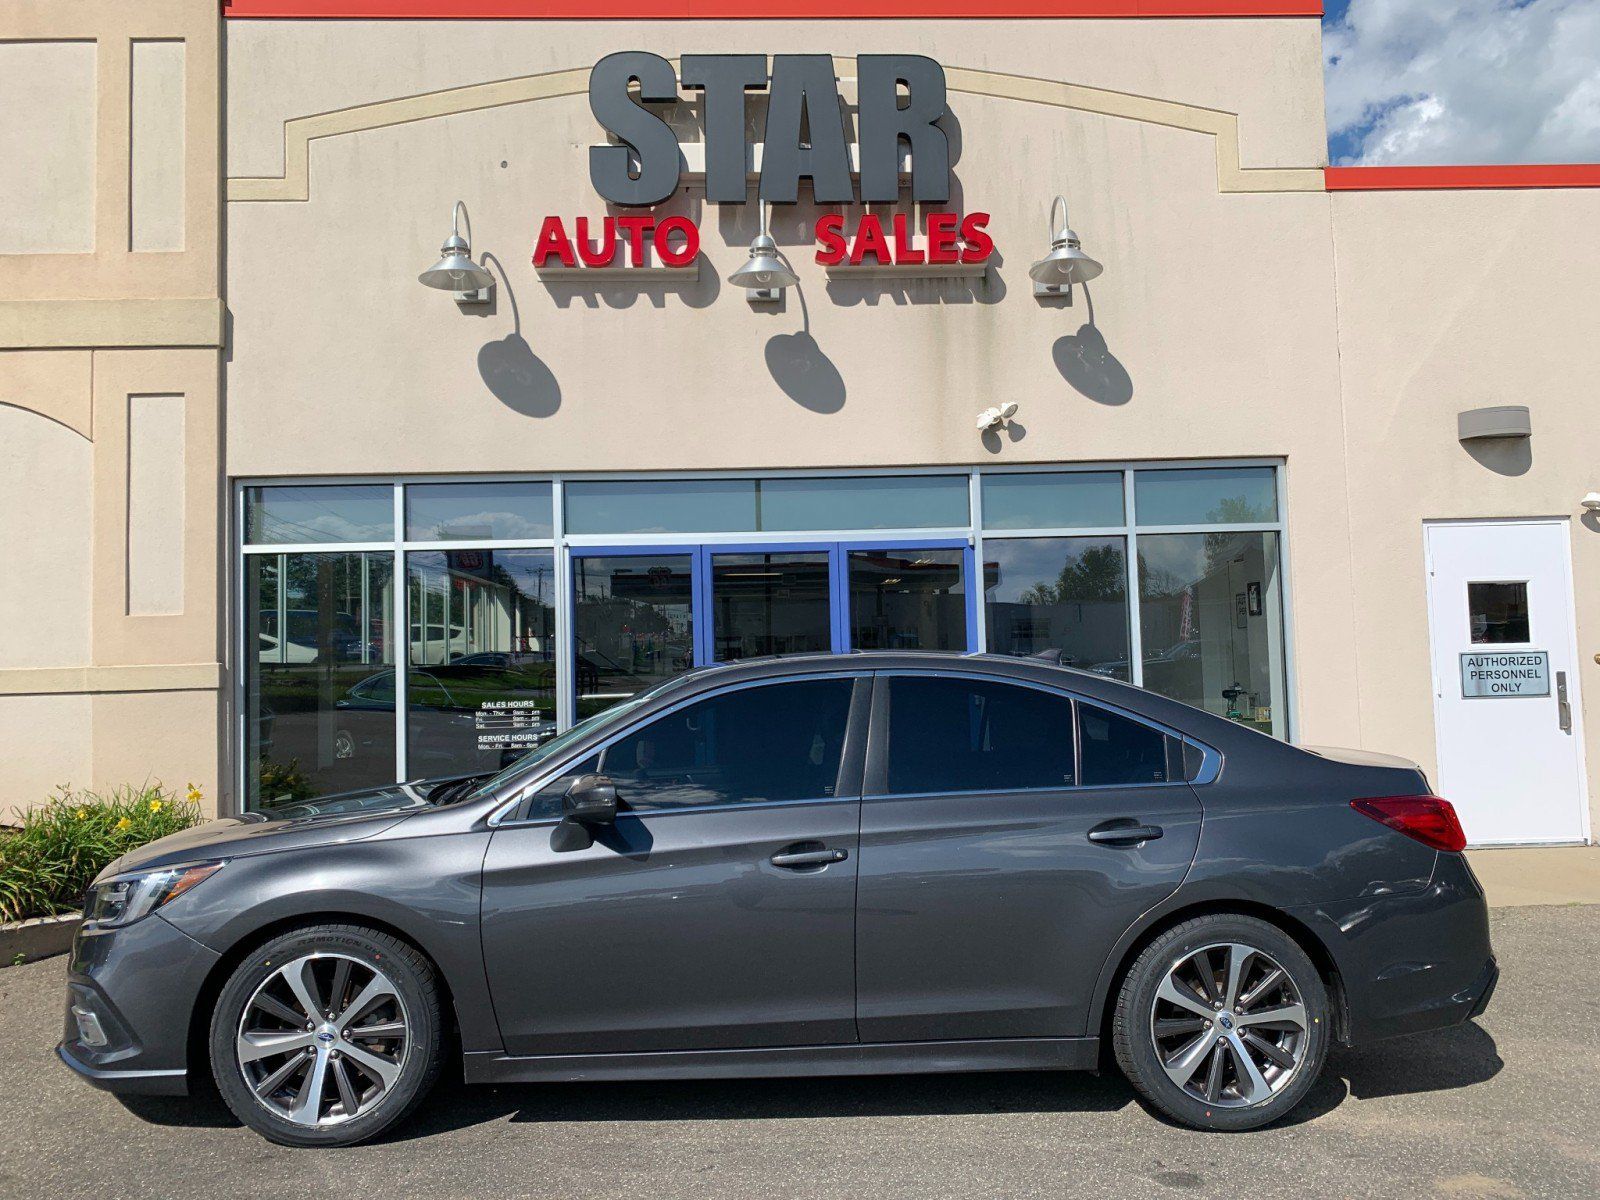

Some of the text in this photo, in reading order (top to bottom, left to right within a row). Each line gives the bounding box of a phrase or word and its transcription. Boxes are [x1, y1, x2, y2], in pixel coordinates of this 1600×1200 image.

[588, 50, 951, 207] STAR
[531, 211, 994, 269] AUTO SALES
[1467, 655, 1542, 667] AUTHORIZED
[1470, 669, 1542, 680] PERSONNEL
[1491, 682, 1522, 693] ONLY
[507, 700, 534, 708] HOURS
[511, 733, 538, 741] HOURS
